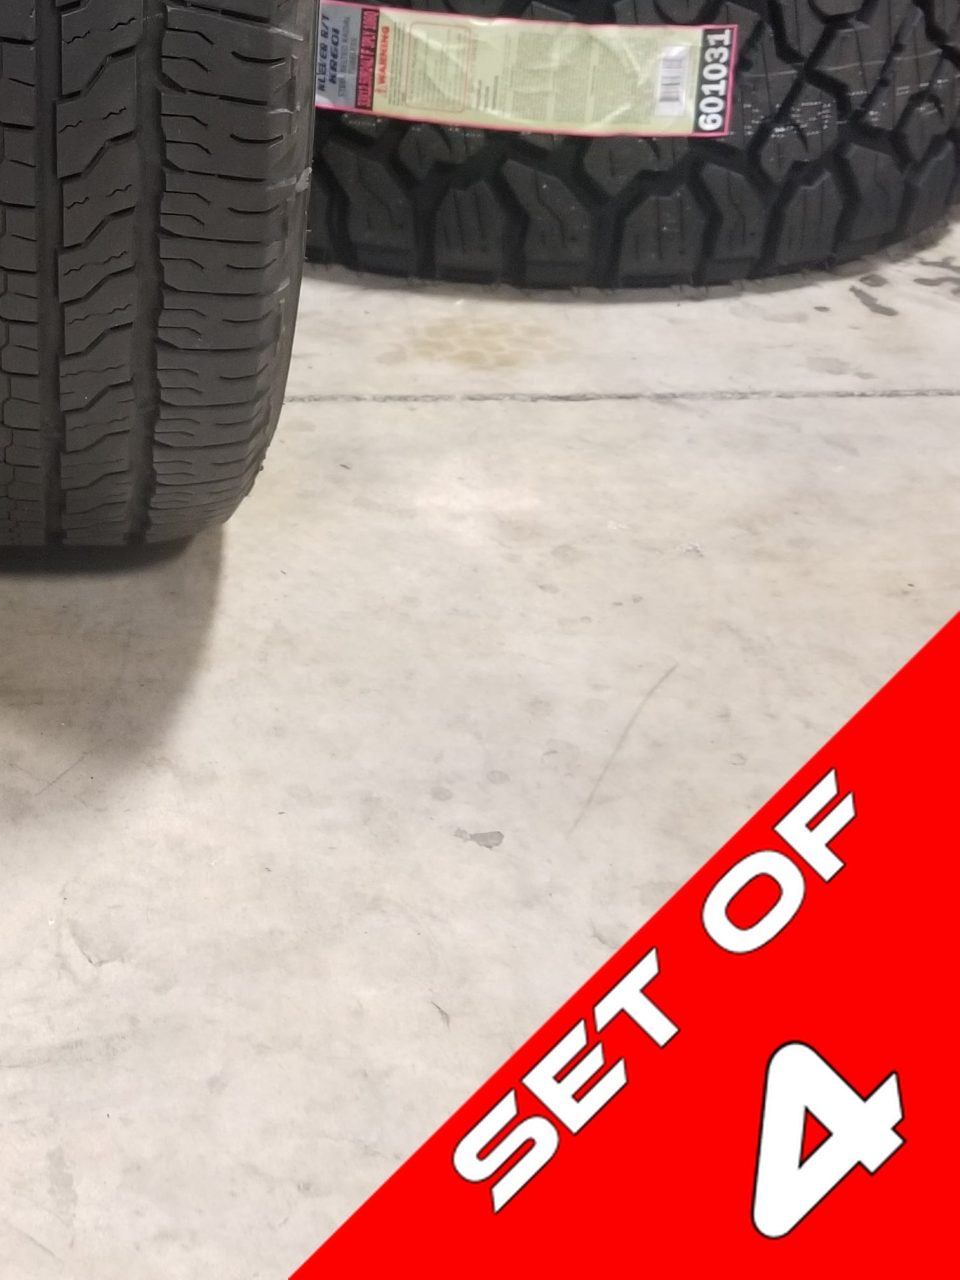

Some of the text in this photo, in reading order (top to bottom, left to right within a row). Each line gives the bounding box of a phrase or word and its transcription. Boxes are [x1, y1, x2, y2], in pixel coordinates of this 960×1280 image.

[317, 13, 329, 92] KLEVER R/T
[329, 27, 340, 84] KR601
[378, 25, 390, 83] WARNING
[698, 29, 731, 131] 601031
